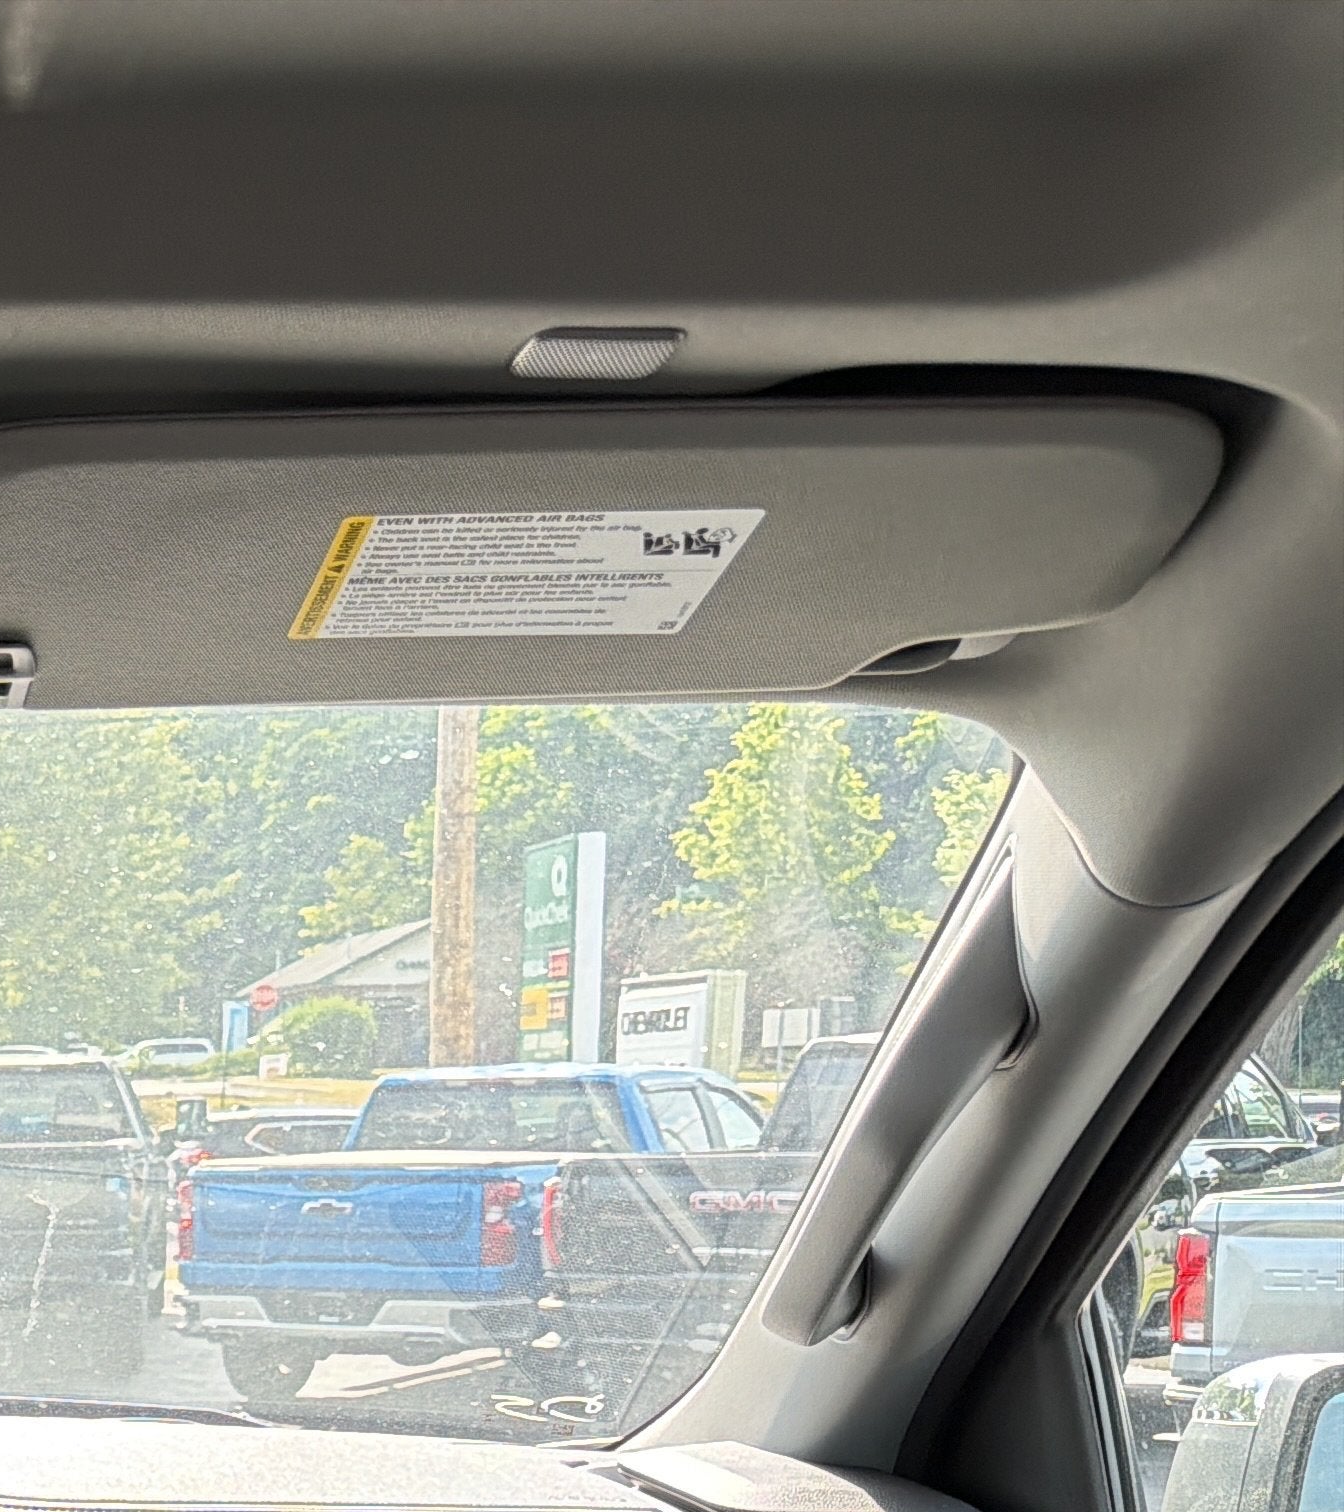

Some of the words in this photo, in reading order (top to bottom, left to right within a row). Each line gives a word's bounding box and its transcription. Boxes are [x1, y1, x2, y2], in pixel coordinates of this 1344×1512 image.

[377, 517, 414, 526] EVEN
[417, 516, 454, 525] WITH
[456, 515, 534, 524] ADVANCED
[536, 514, 562, 522] AIR
[564, 513, 605, 522] BAGS
[334, 521, 366, 562] WARNING
[388, 576, 422, 584] AVEC
[425, 576, 451, 584] DES
[453, 575, 488, 583] SACS
[490, 574, 573, 582] GONFLABLES
[575, 573, 664, 581] INTELLIGENTS
[689, 1190, 803, 1213] GMC
